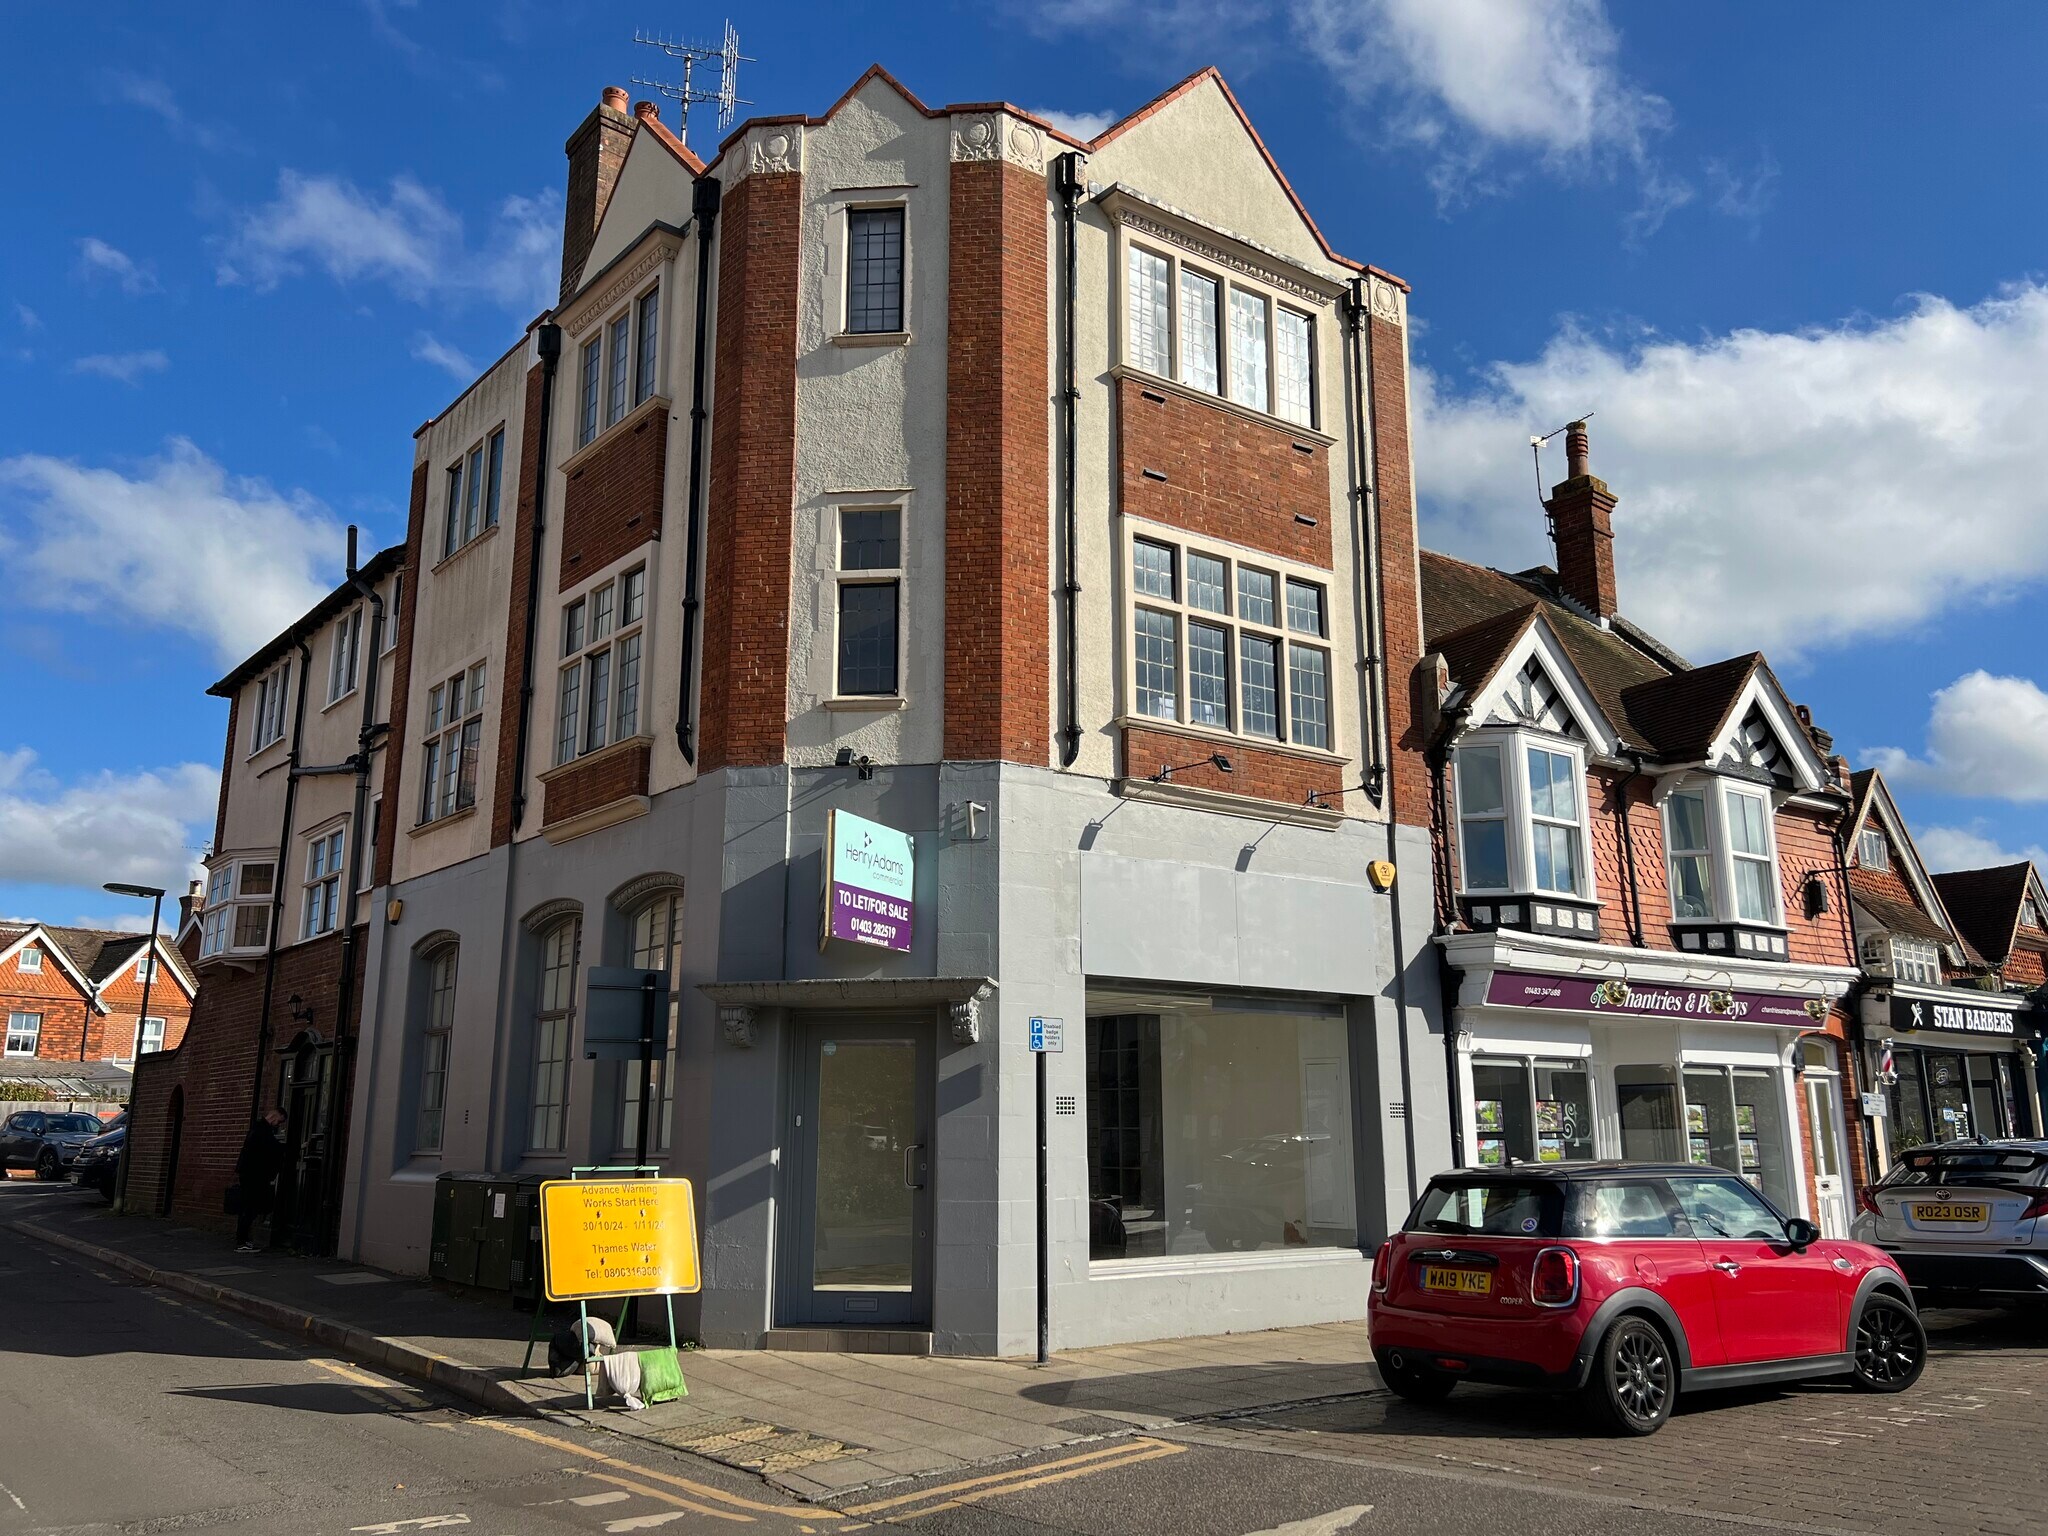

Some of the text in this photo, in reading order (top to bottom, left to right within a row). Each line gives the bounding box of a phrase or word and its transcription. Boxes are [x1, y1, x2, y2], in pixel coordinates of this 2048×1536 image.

[845, 843, 904, 876] Henry Adams
[872, 872, 904, 887] commercial
[839, 889, 909, 922] TO LET/FOR SALE
[851, 917, 896, 939] 01403 282519
[1684, 992, 1697, 1013] &
[1933, 1005, 2014, 1034] STAN BARBERS
[1033, 1021, 1041, 1033] P
[582, 1183, 658, 1195] Advance Warning
[583, 1197, 659, 1208] Works Start Here
[1917, 1205, 1981, 1218] RO23 OSR
[583, 1221, 623, 1231] 30/10/24
[592, 1242, 657, 1254] Thames Water
[585, 1269, 602, 1279] Tel:
[1430, 1270, 1487, 1290] WA19 YKE
[1500, 1296, 1524, 1305] COOPER
